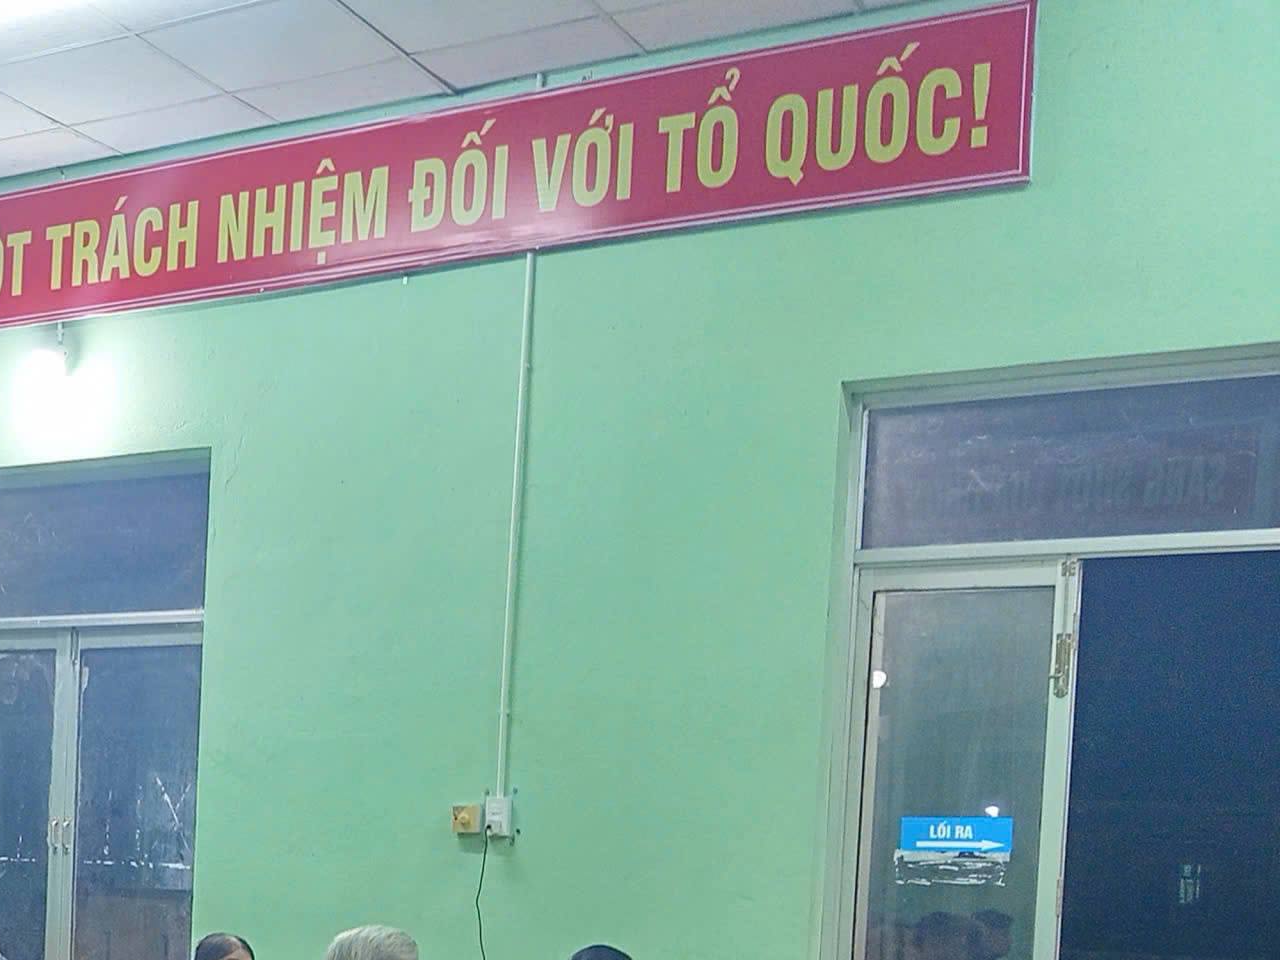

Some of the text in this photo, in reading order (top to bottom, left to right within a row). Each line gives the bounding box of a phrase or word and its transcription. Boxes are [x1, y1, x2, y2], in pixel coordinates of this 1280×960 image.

[45, 195, 200, 291] TRÁCH
[216, 157, 390, 265] NHIỆM
[407, 118, 509, 233] ĐỐI
[531, 107, 634, 213] VỚI
[658, 66, 741, 194] TỔ
[765, 41, 992, 187] QUỐC!
[929, 820, 974, 839] LỐI RA
